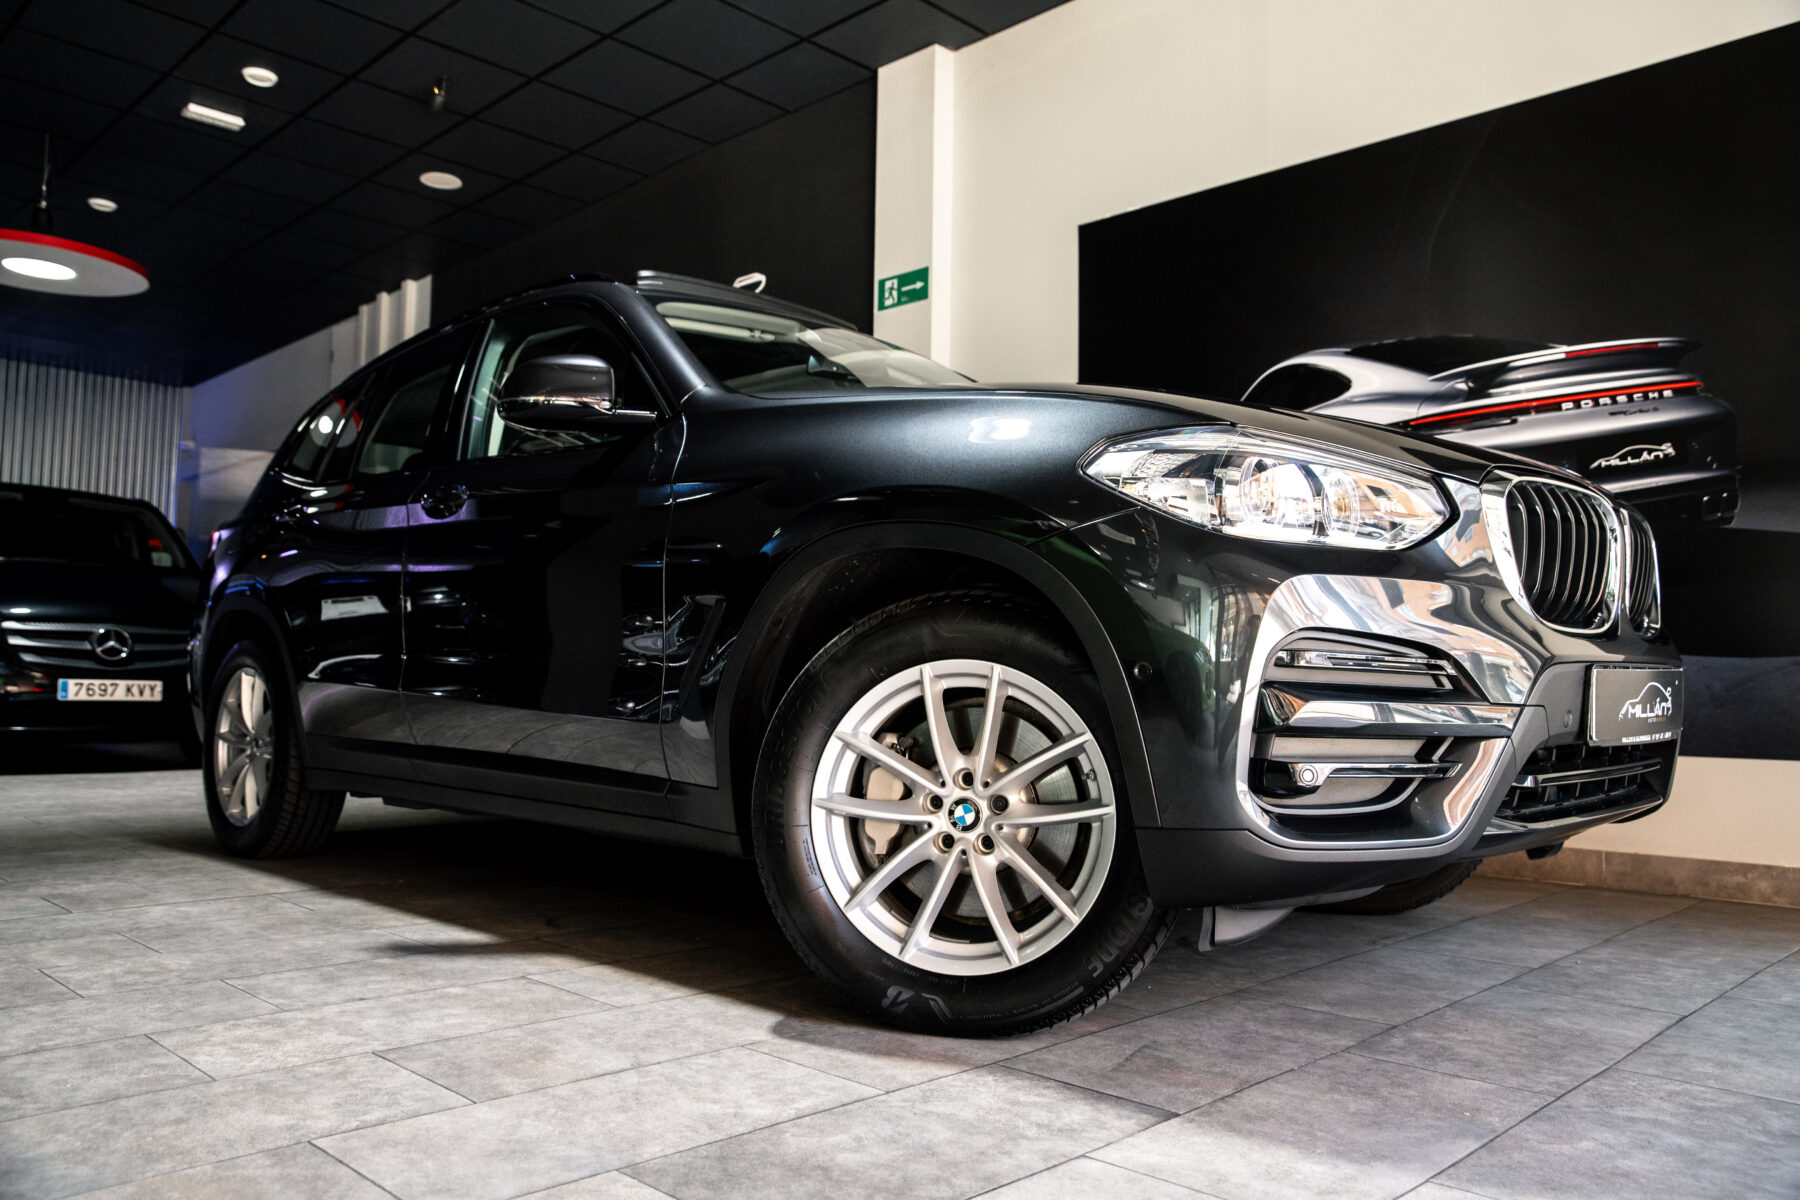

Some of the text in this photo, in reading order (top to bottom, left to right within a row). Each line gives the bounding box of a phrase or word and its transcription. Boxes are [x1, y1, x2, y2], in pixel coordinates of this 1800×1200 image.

[1561, 389, 1673, 411] PORSCHE
[73, 682, 119, 698] 7697
[125, 683, 158, 698] KVY
